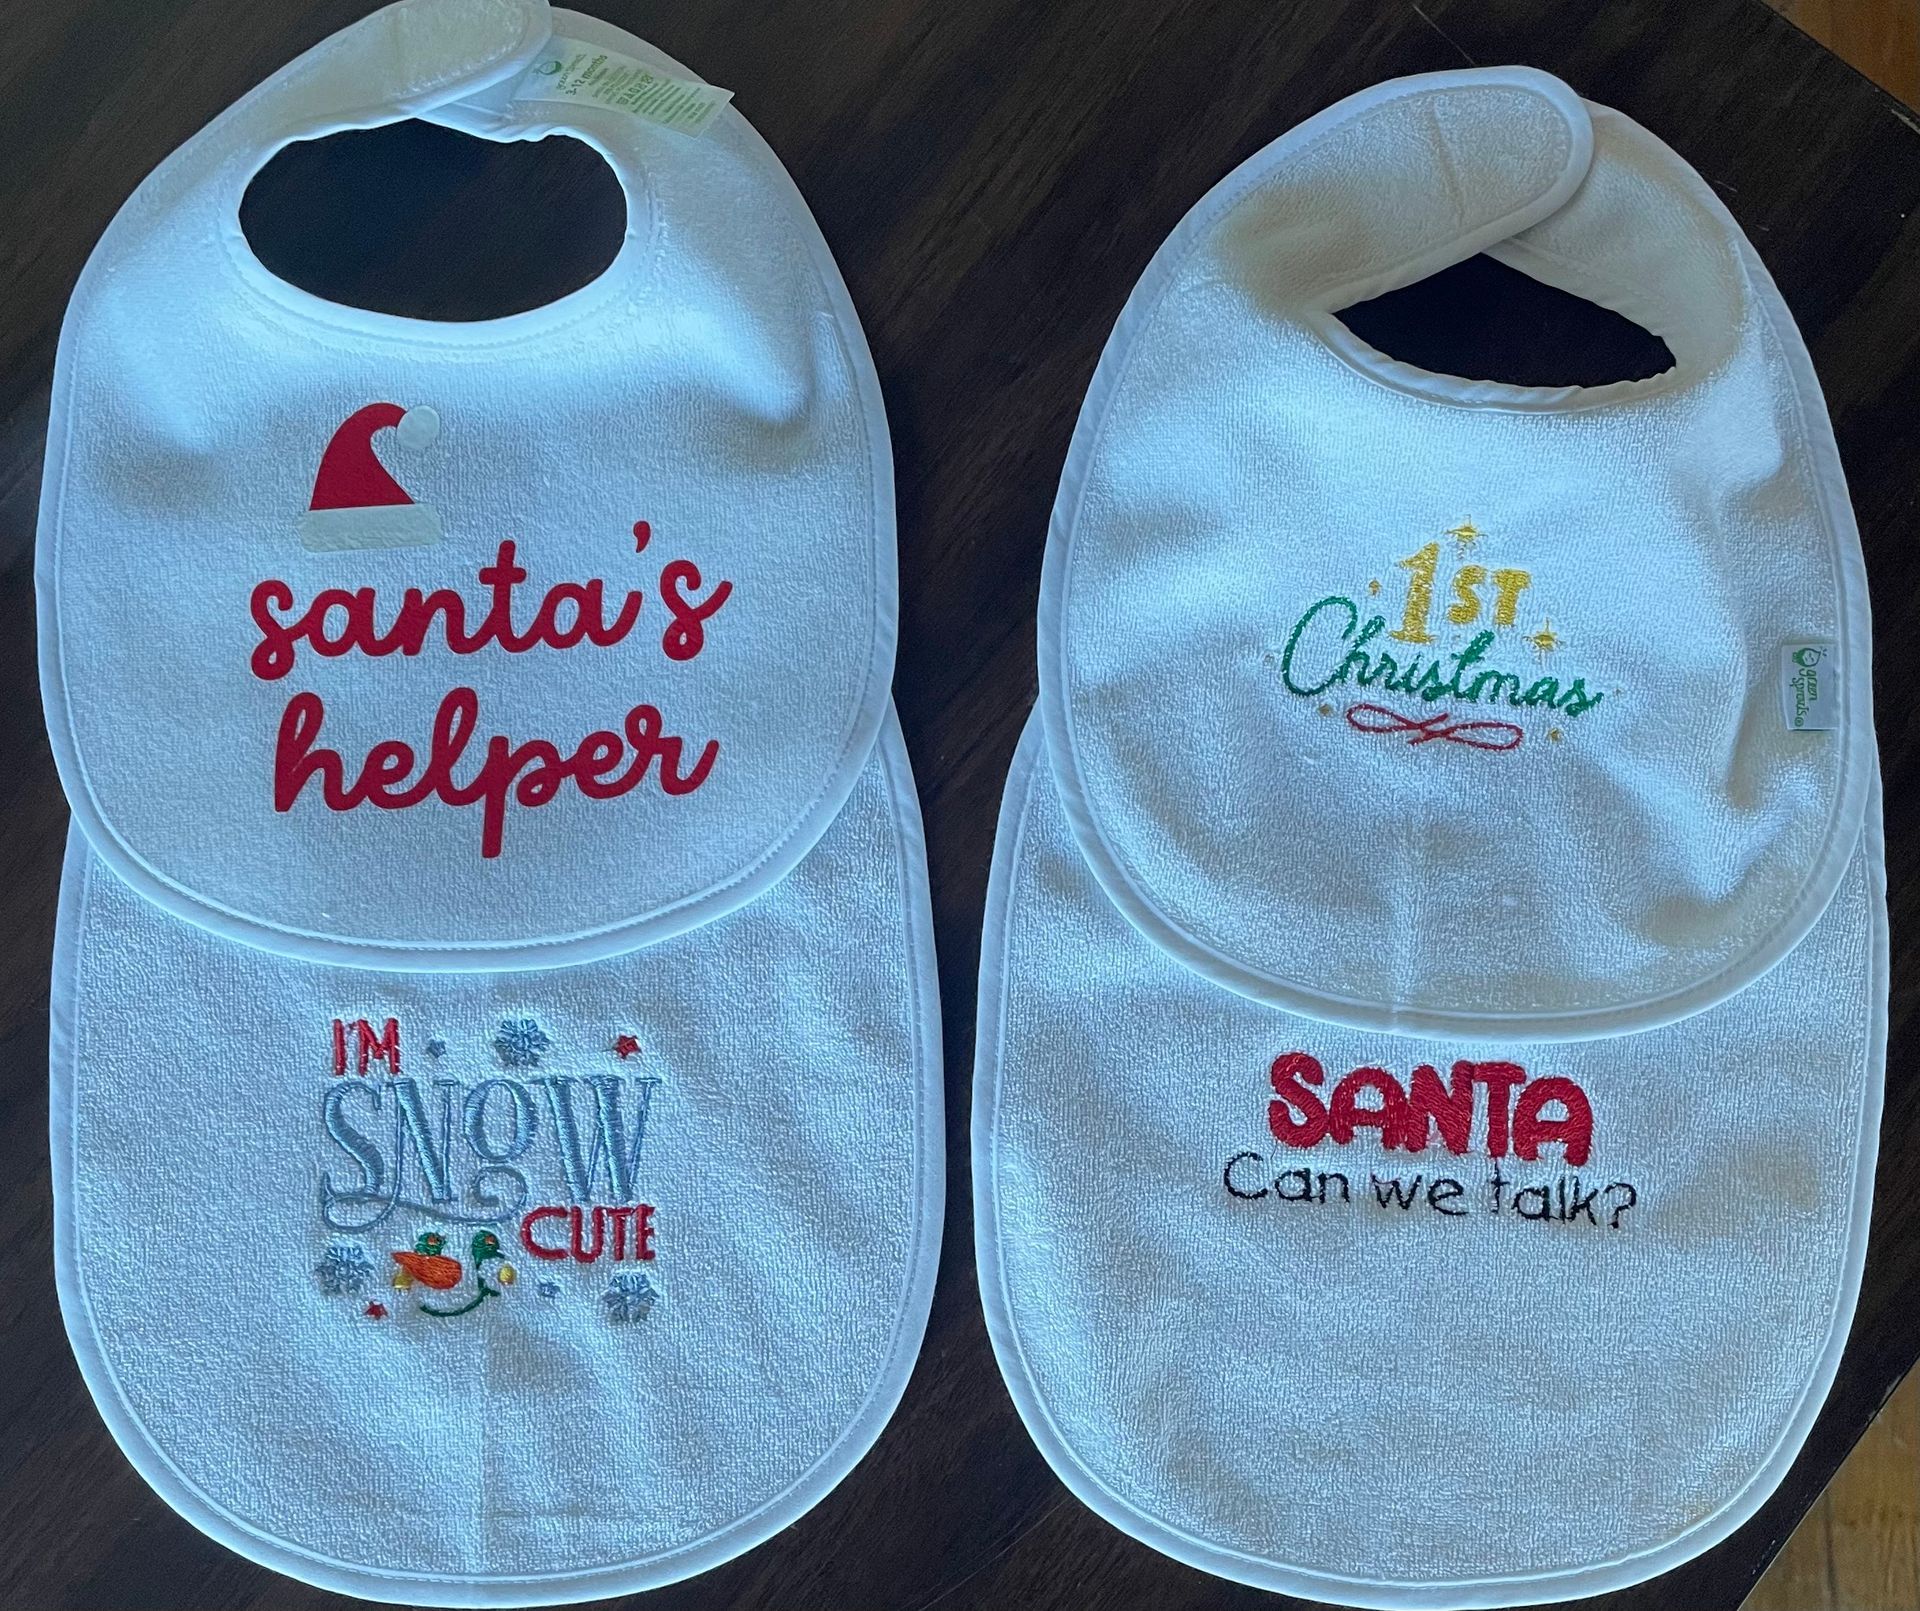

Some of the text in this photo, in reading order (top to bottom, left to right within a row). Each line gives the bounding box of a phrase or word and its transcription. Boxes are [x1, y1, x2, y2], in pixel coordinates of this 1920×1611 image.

[565, 79, 586, 96] 3-12
[582, 54, 608, 80] months
[250, 520, 733, 681] santa's
[1389, 541, 1533, 645] 1ST
[1282, 595, 1605, 717] Christmas
[1799, 668, 1818, 701] green
[274, 686, 720, 859] helper
[332, 1018, 402, 1077] I'M
[320, 1074, 662, 1234] SNOW
[1267, 1050, 1594, 1167] SANTA
[520, 1203, 656, 1263] CUTE
[1223, 1151, 1638, 1229] Can we talk?
